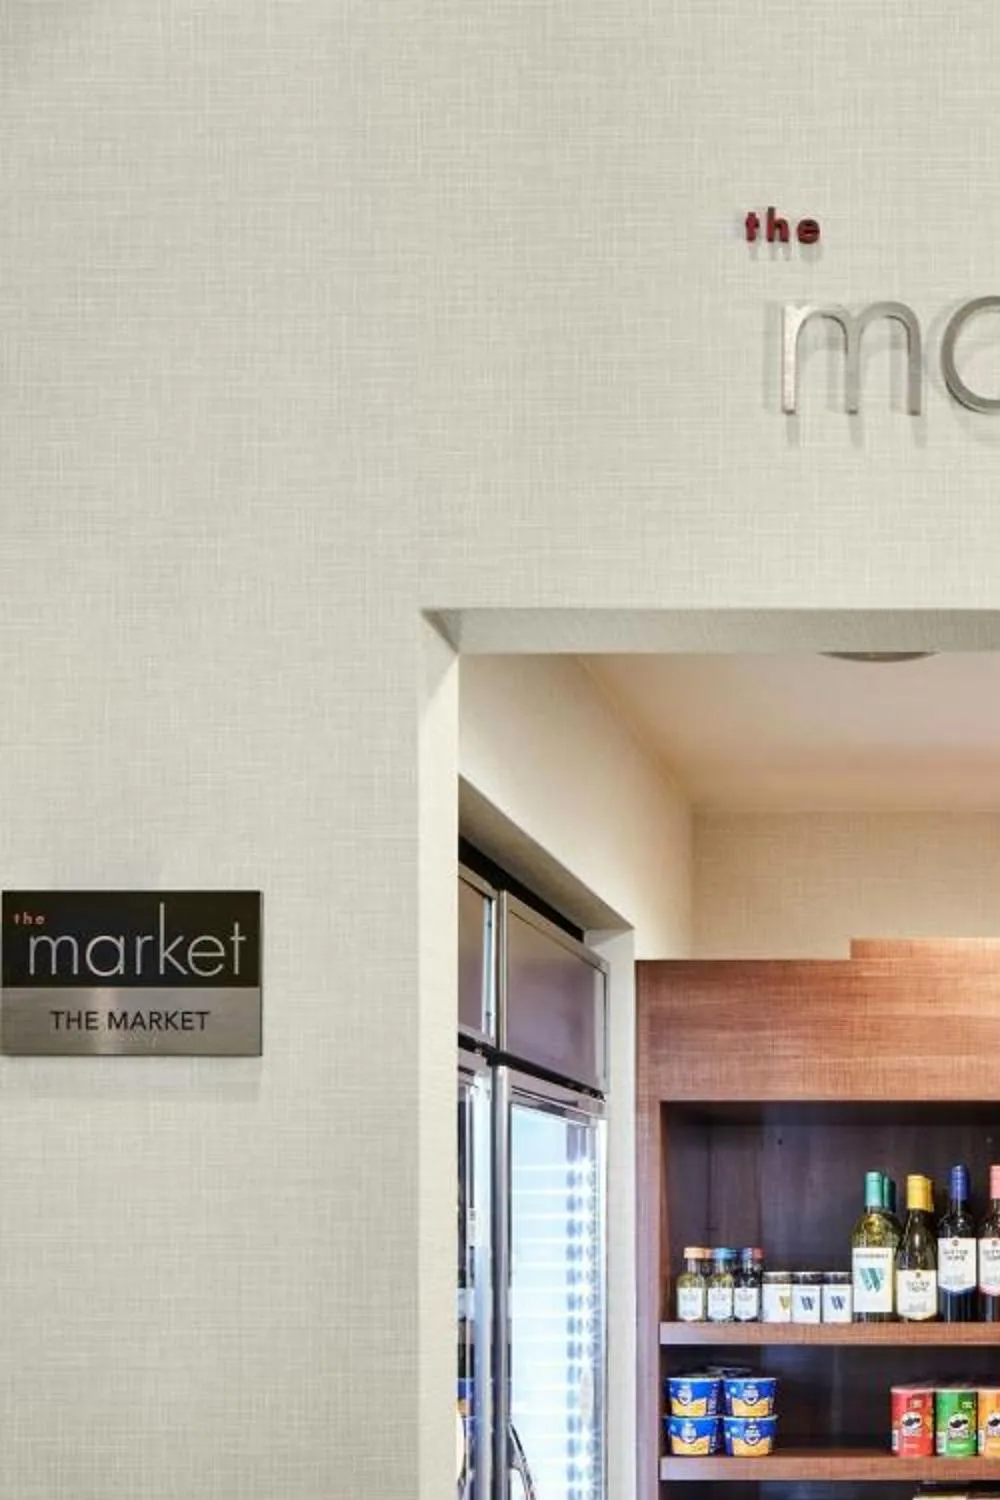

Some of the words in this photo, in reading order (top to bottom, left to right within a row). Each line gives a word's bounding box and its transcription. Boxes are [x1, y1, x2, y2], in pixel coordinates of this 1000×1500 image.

[745, 205, 821, 244] the
[13, 911, 46, 926] the
[28, 901, 247, 977] market
[50, 1010, 99, 1031] THE
[107, 1010, 211, 1031] MARKET
